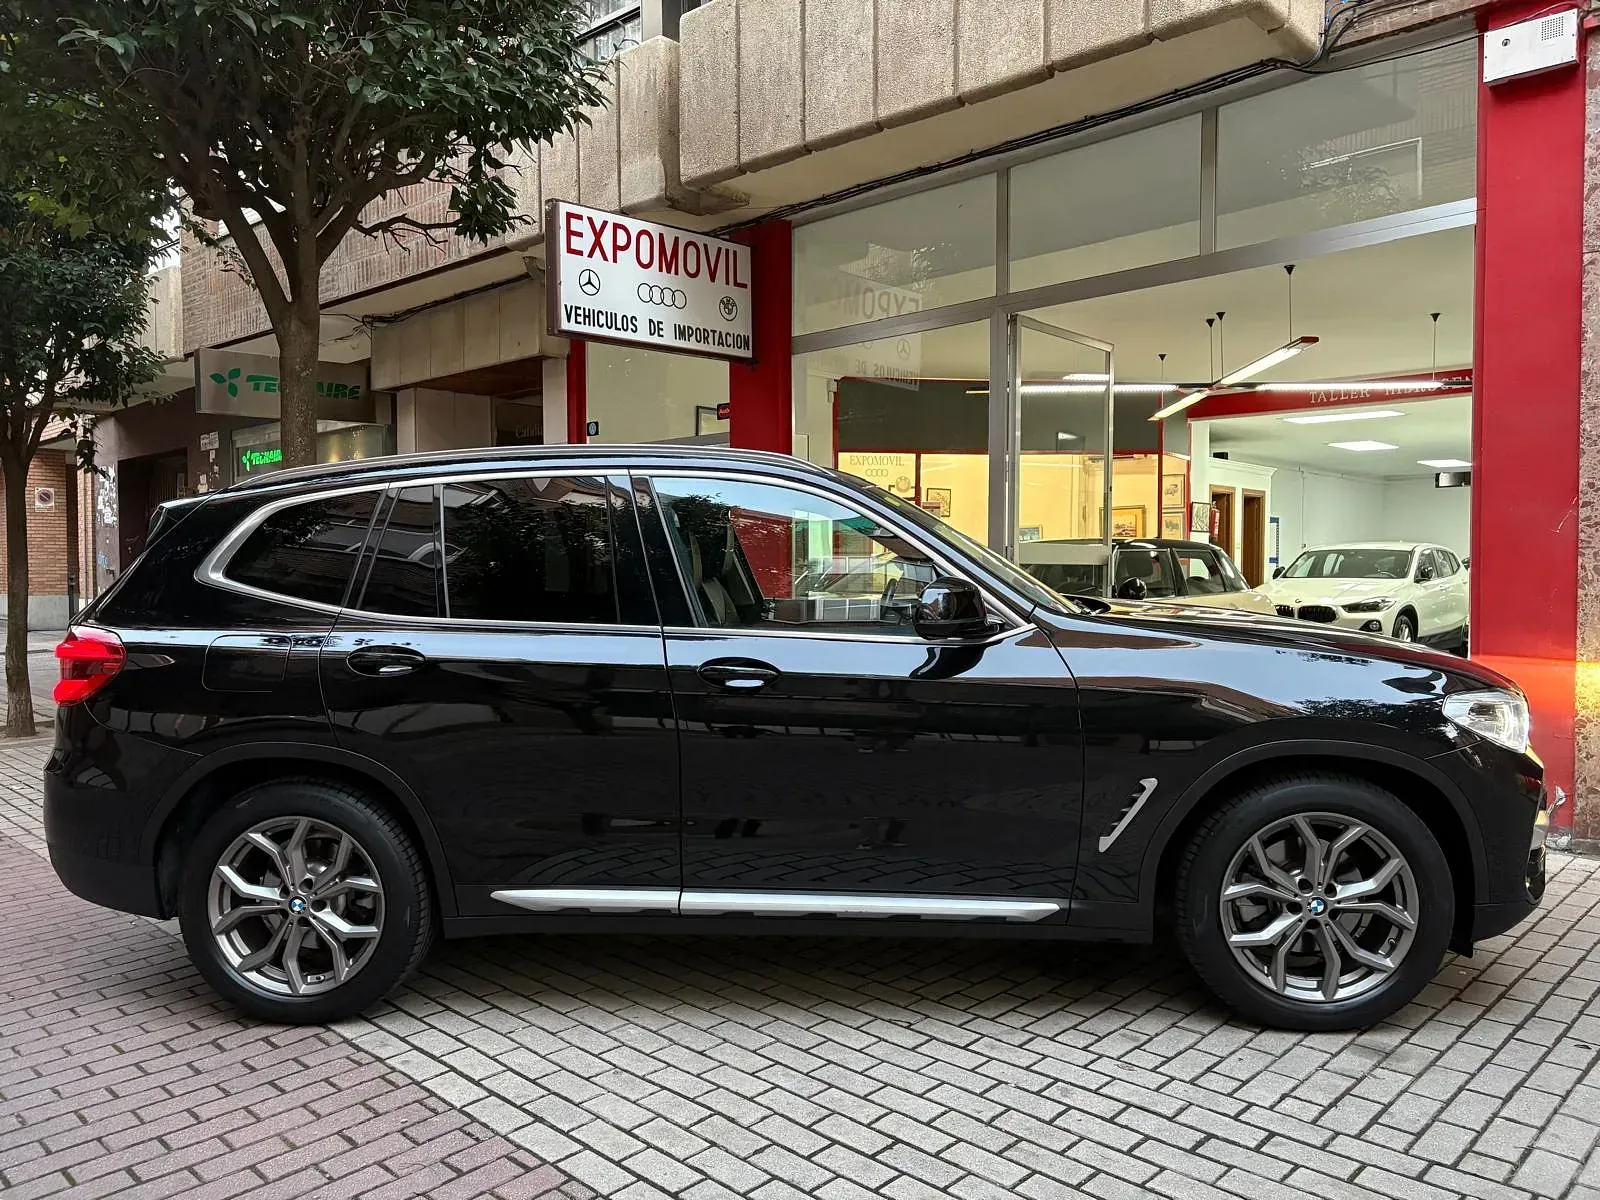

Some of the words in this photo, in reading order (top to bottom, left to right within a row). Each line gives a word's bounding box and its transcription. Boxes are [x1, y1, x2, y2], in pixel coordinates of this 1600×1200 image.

[565, 211, 748, 289] EXPOMOVIL
[564, 304, 638, 333] VEHICULOS
[649, 319, 664, 337] DE
[674, 323, 750, 351] IMPORTACION
[1309, 388, 1371, 403] TALLER
[850, 455, 905, 466] EXPOMOVIL
